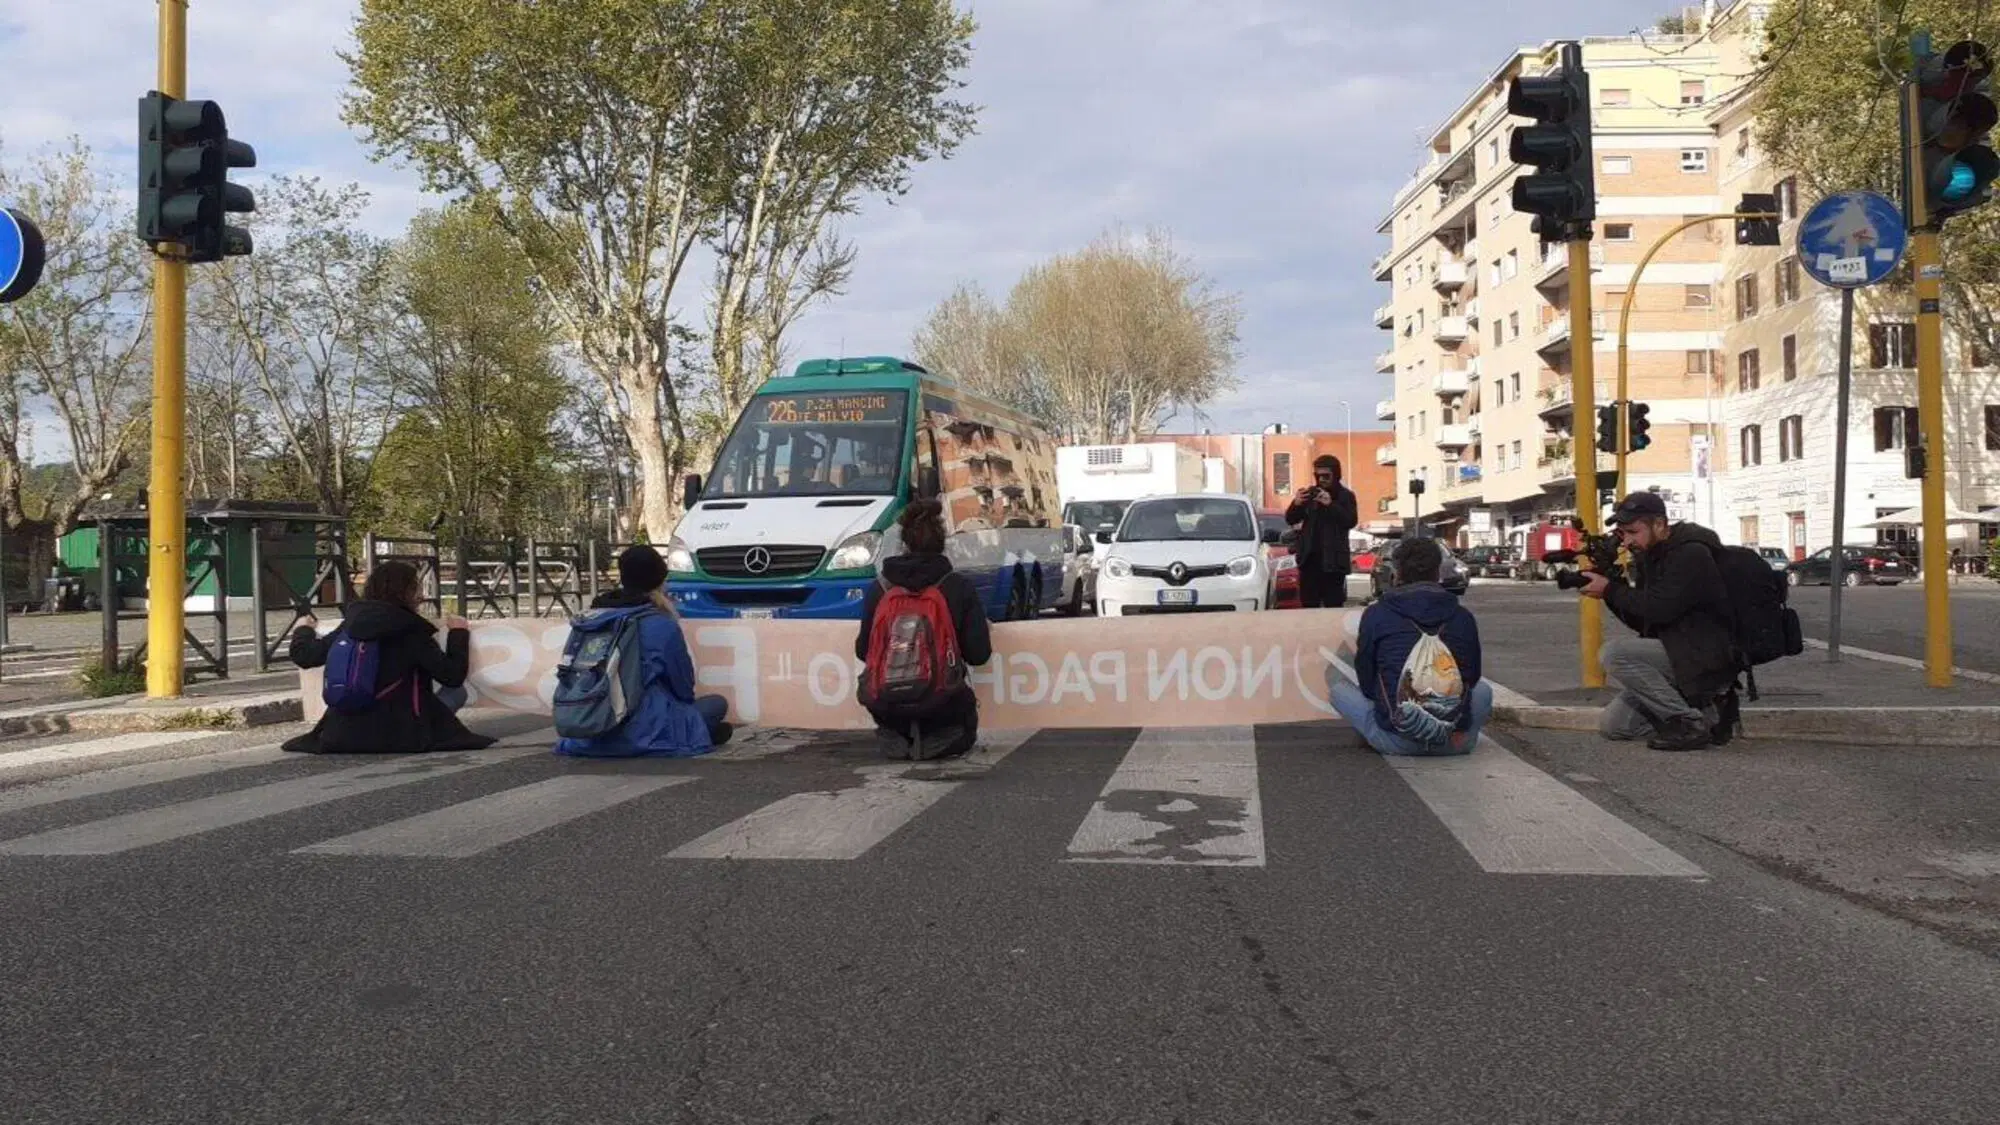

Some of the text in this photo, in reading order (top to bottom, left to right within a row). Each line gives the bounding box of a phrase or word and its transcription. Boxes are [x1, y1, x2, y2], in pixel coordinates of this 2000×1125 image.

[836, 396, 886, 410] MANCINI
[768, 399, 798, 422] 226
[816, 409, 865, 422] MILVIO
